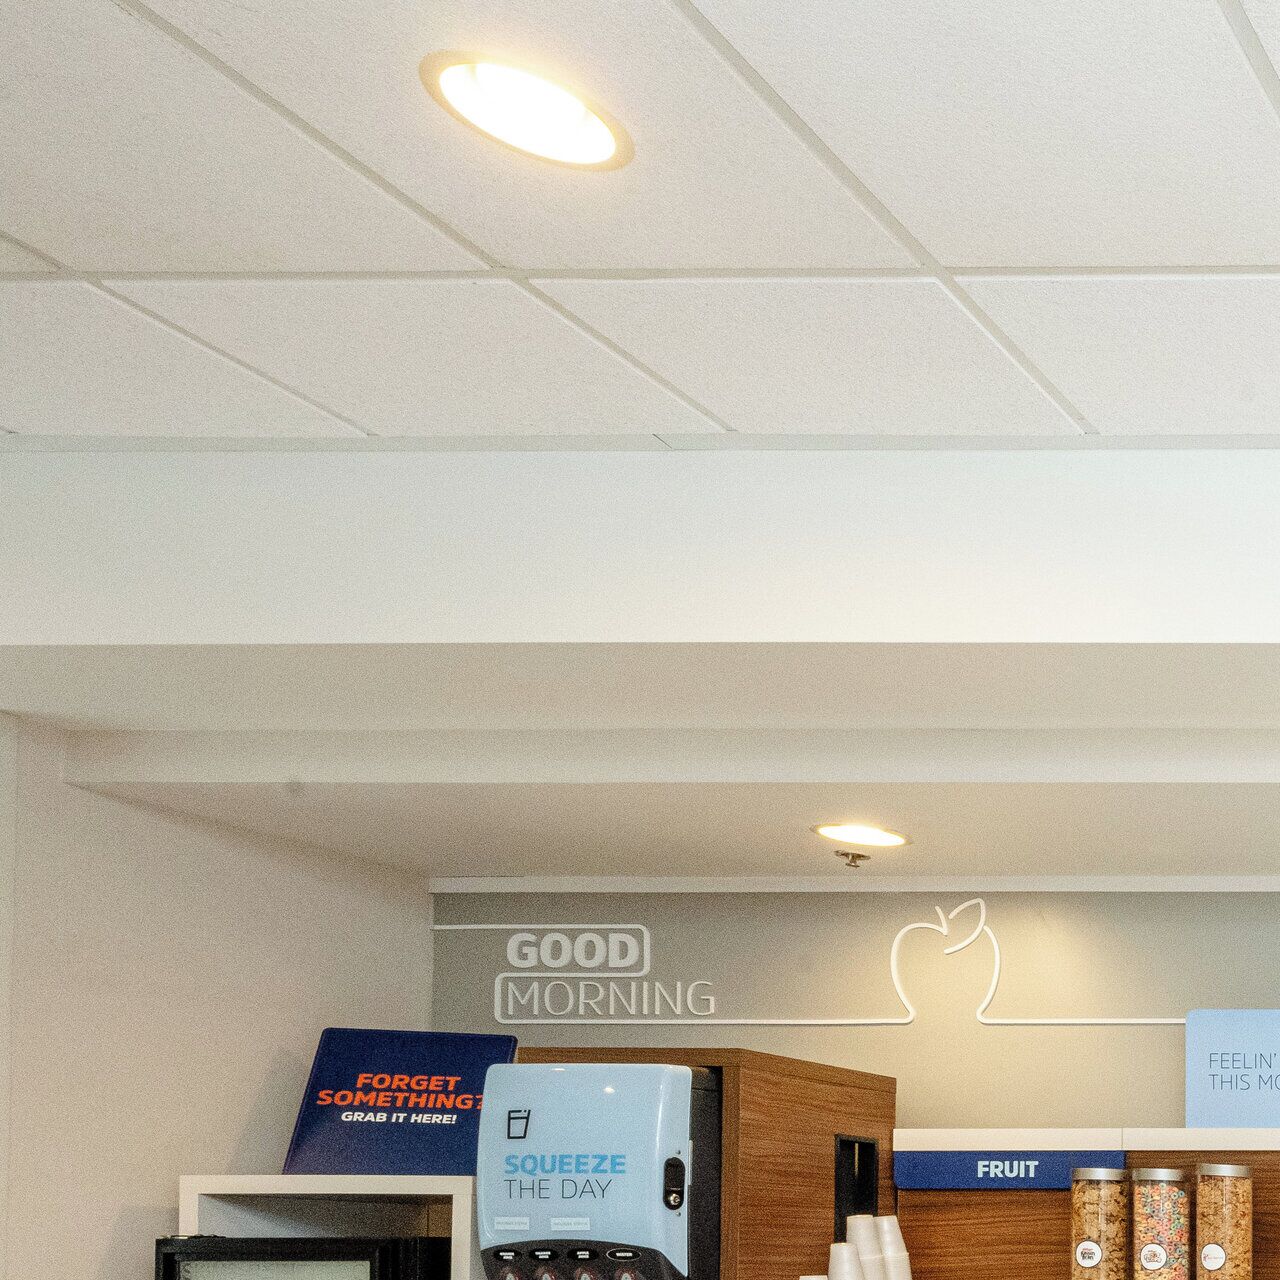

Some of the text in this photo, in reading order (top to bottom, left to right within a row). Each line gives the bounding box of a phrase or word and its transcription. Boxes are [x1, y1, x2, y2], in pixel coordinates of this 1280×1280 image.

[506, 932, 640, 968] GOOD
[507, 980, 715, 1015] MORNING
[356, 1073, 461, 1091] FORGET
[1208, 1074, 1251, 1091] THIS
[341, 1112, 457, 1124] GRAB IT HERE!
[504, 1154, 627, 1176] SQUEEZE
[977, 1160, 1039, 1178] FRUIT
[504, 1179, 613, 1199] THE DAY
